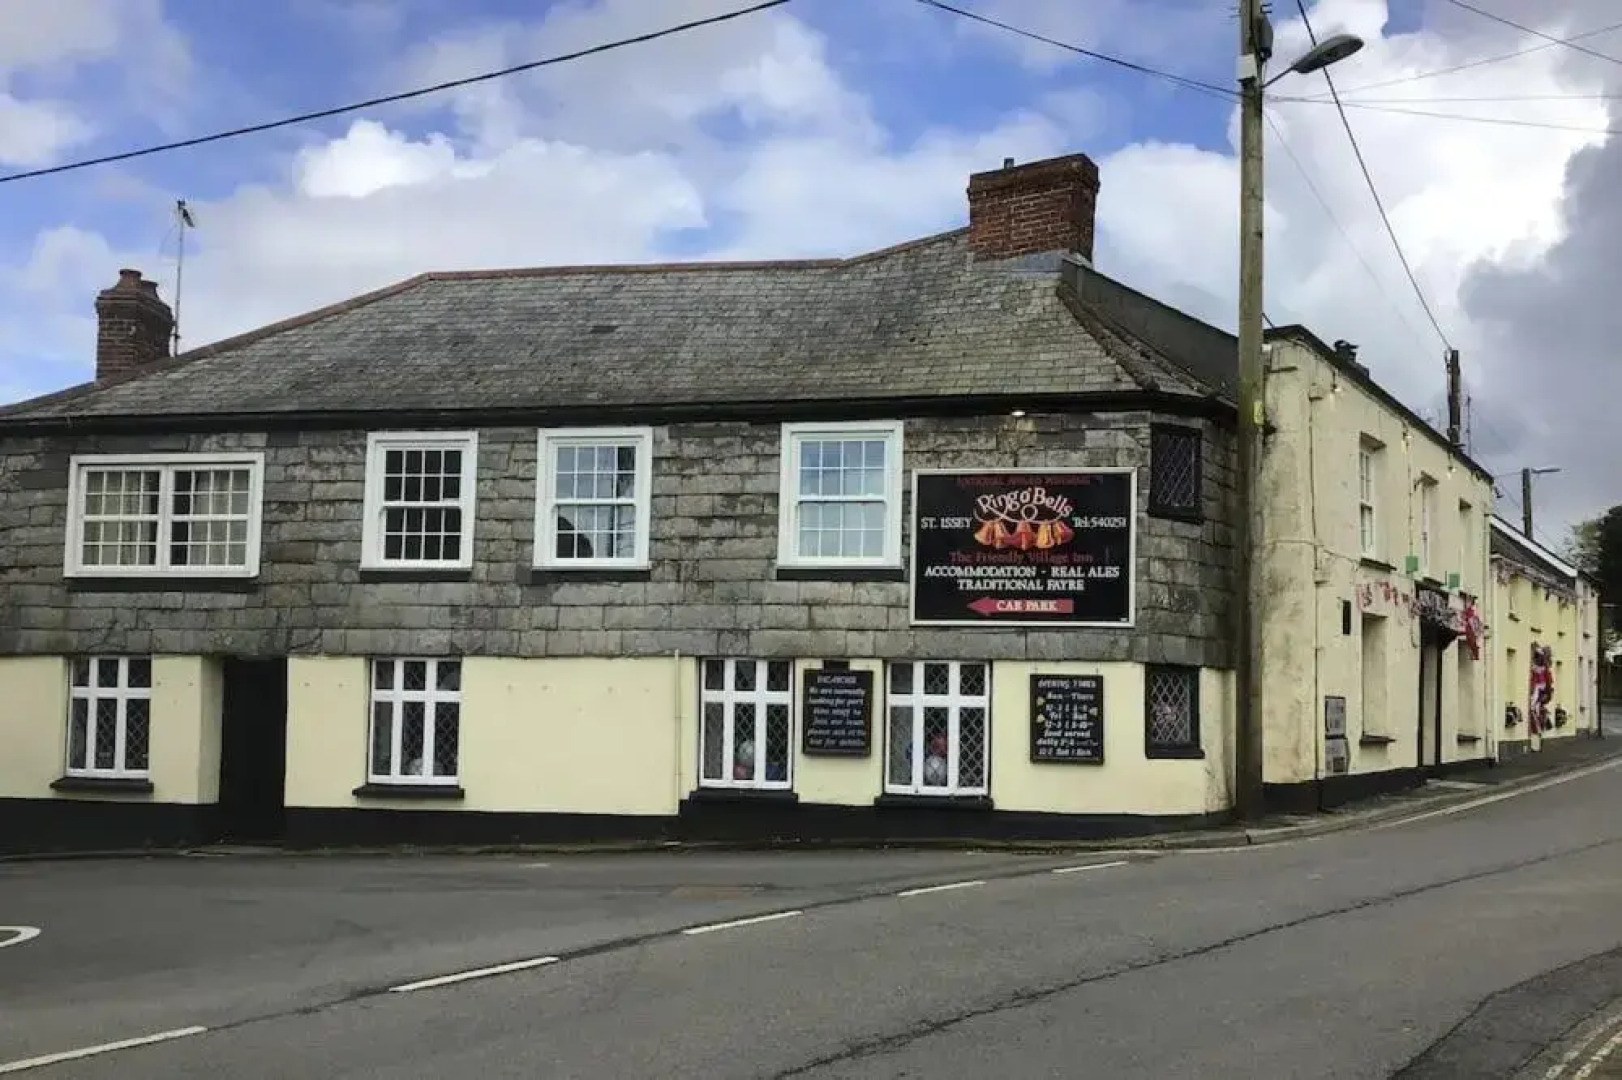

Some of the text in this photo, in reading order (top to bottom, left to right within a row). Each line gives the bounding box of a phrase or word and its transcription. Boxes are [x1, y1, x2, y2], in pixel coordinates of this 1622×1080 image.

[977, 491, 1020, 514] Ring
[1033, 487, 1073, 518] Bells
[921, 516, 973, 529] ST. ISSEY
[924, 565, 1037, 577] ACCOMMODATION
[1051, 565, 1085, 577] REAL
[1088, 565, 1120, 577] ALES
[957, 579, 1084, 591] TRADITIONAL FAYRE
[996, 600, 1058, 612] CAR PARK
